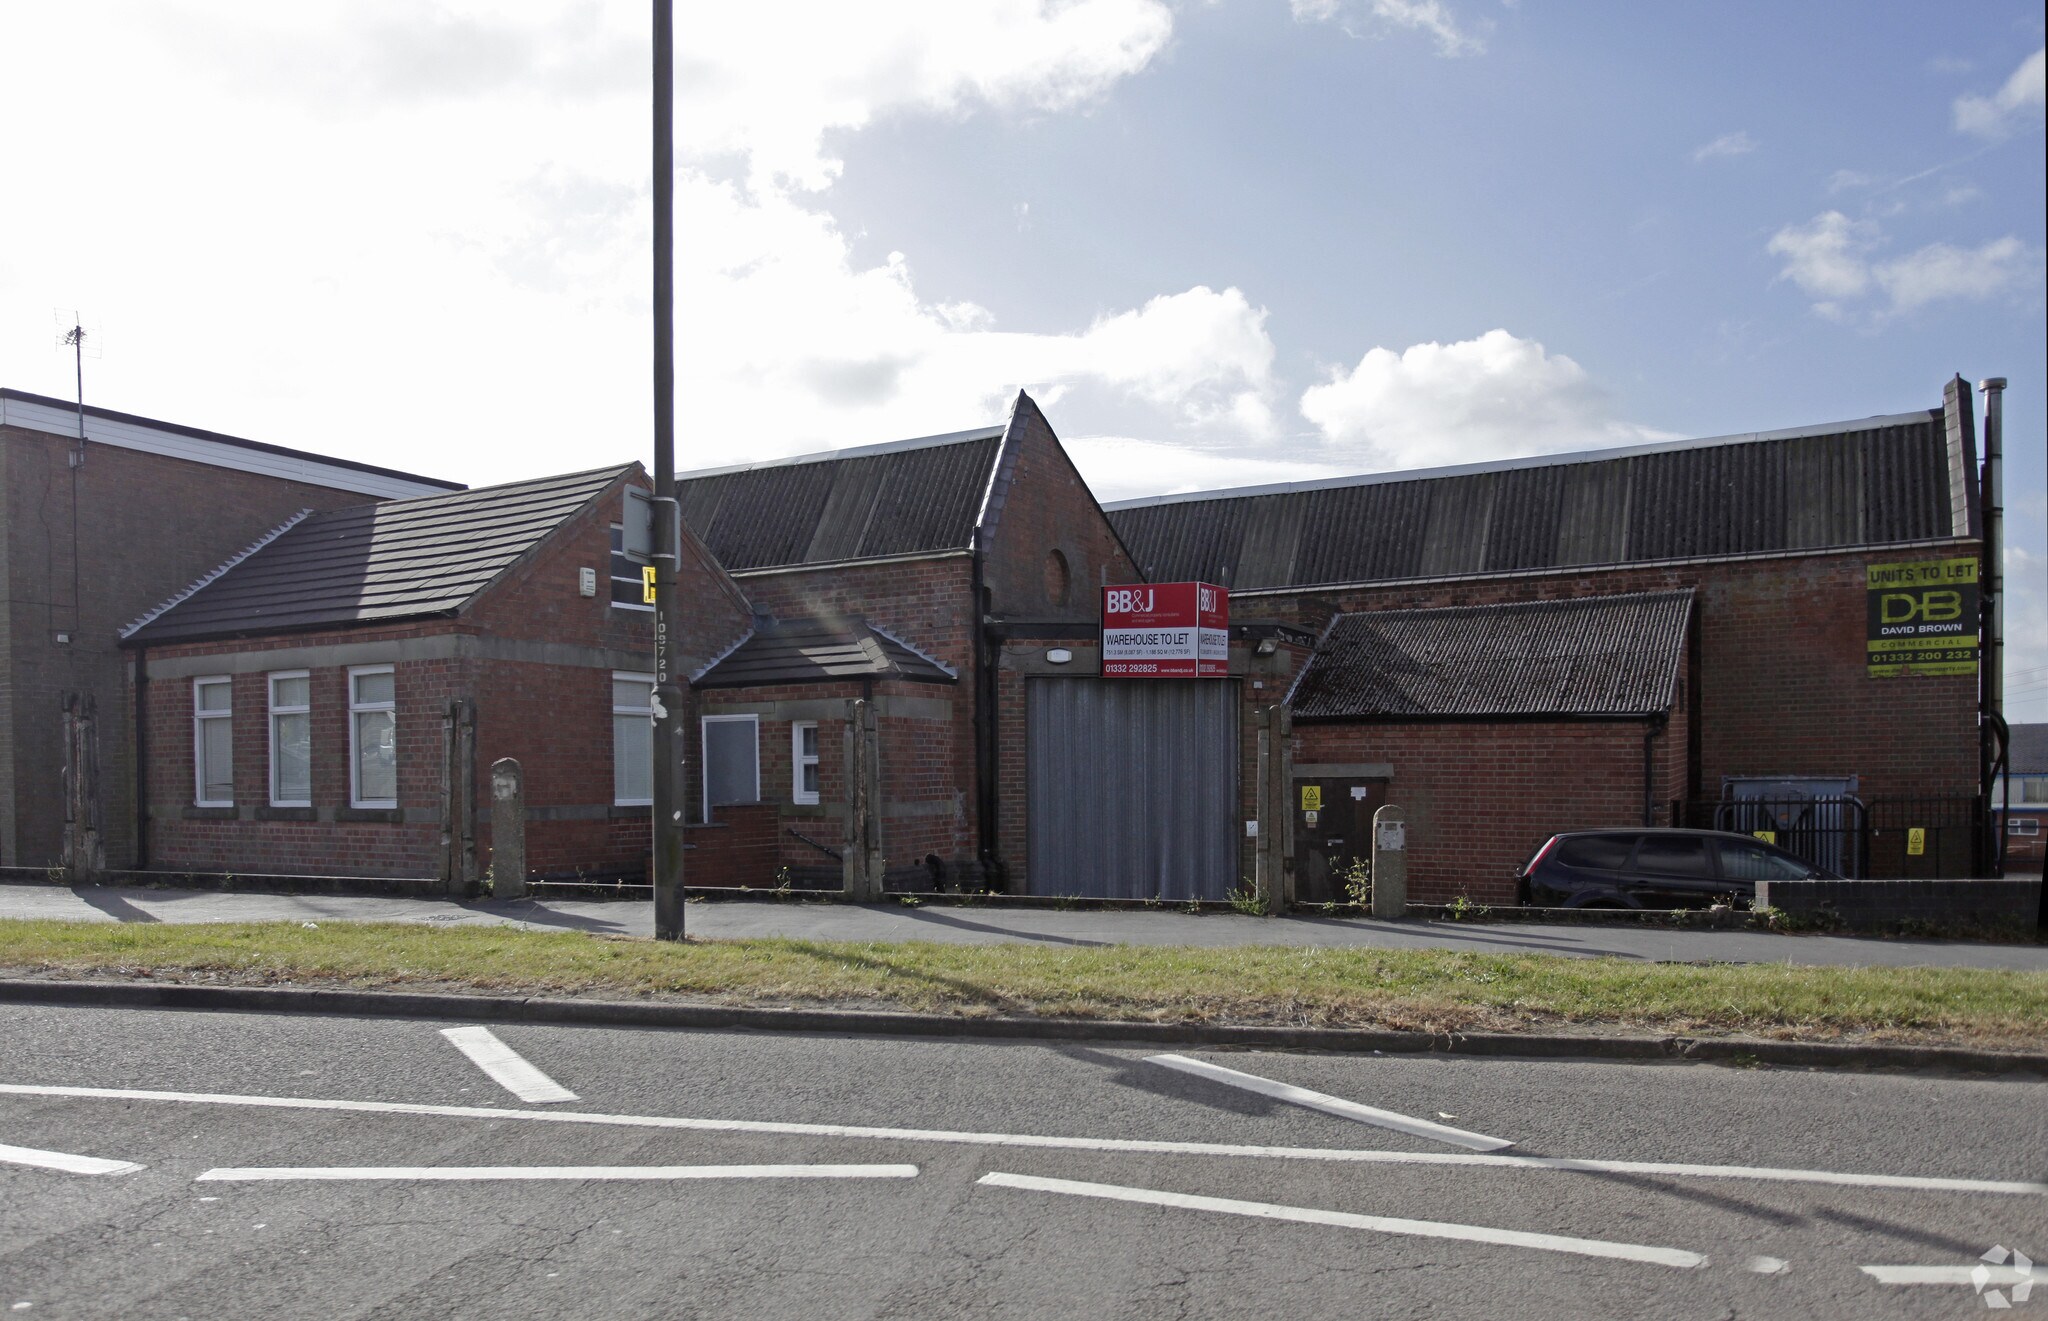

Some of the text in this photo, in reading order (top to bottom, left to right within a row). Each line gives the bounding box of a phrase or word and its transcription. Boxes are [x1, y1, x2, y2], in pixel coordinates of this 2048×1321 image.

[1870, 564, 1974, 583] UNITS TO LET
[1107, 589, 1154, 613] BB&J
[1200, 588, 1216, 613] BB&J
[1881, 624, 1962, 635] DAVID BROWN
[1105, 633, 1189, 646] WAREHOUSE TO LET
[1881, 639, 1962, 649] COMMERCIAL
[1873, 650, 1971, 663] 01332 200 232
[1105, 664, 1127, 673] 01332
[1129, 664, 1157, 672] 292825
